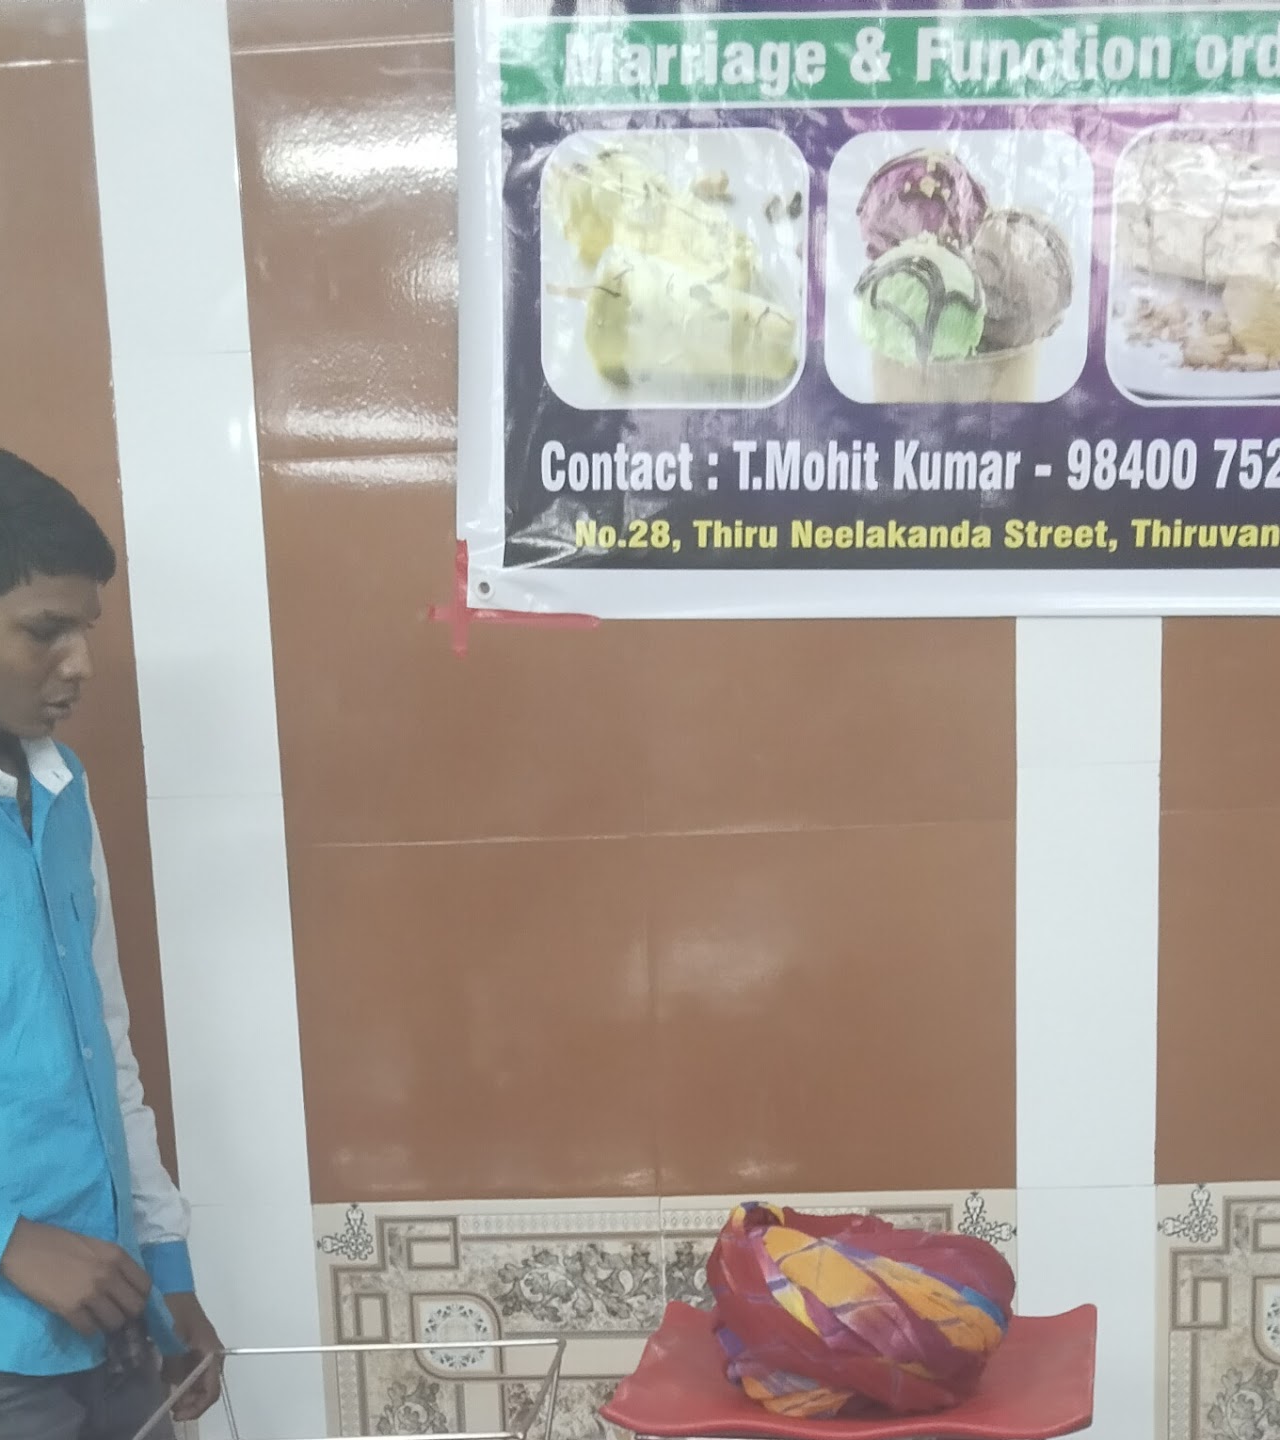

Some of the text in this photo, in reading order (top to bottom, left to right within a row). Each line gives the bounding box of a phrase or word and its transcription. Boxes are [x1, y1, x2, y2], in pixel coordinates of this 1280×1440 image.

[563, 30, 826, 98] Marriage
[849, 26, 892, 84] &
[917, 24, 1172, 86] Function
[541, 439, 693, 492] Contact
[707, 451, 719, 490] :
[733, 440, 878, 491] T.Mohit
[894, 439, 1022, 491] Kumar
[1034, 463, 1053, 477] -
[1067, 437, 1198, 491] 98400
[575, 519, 681, 553] No.28,
[693, 519, 778, 549] Thiru
[791, 519, 992, 549] Neelakanda
[1004, 519, 1118, 552] Street,
